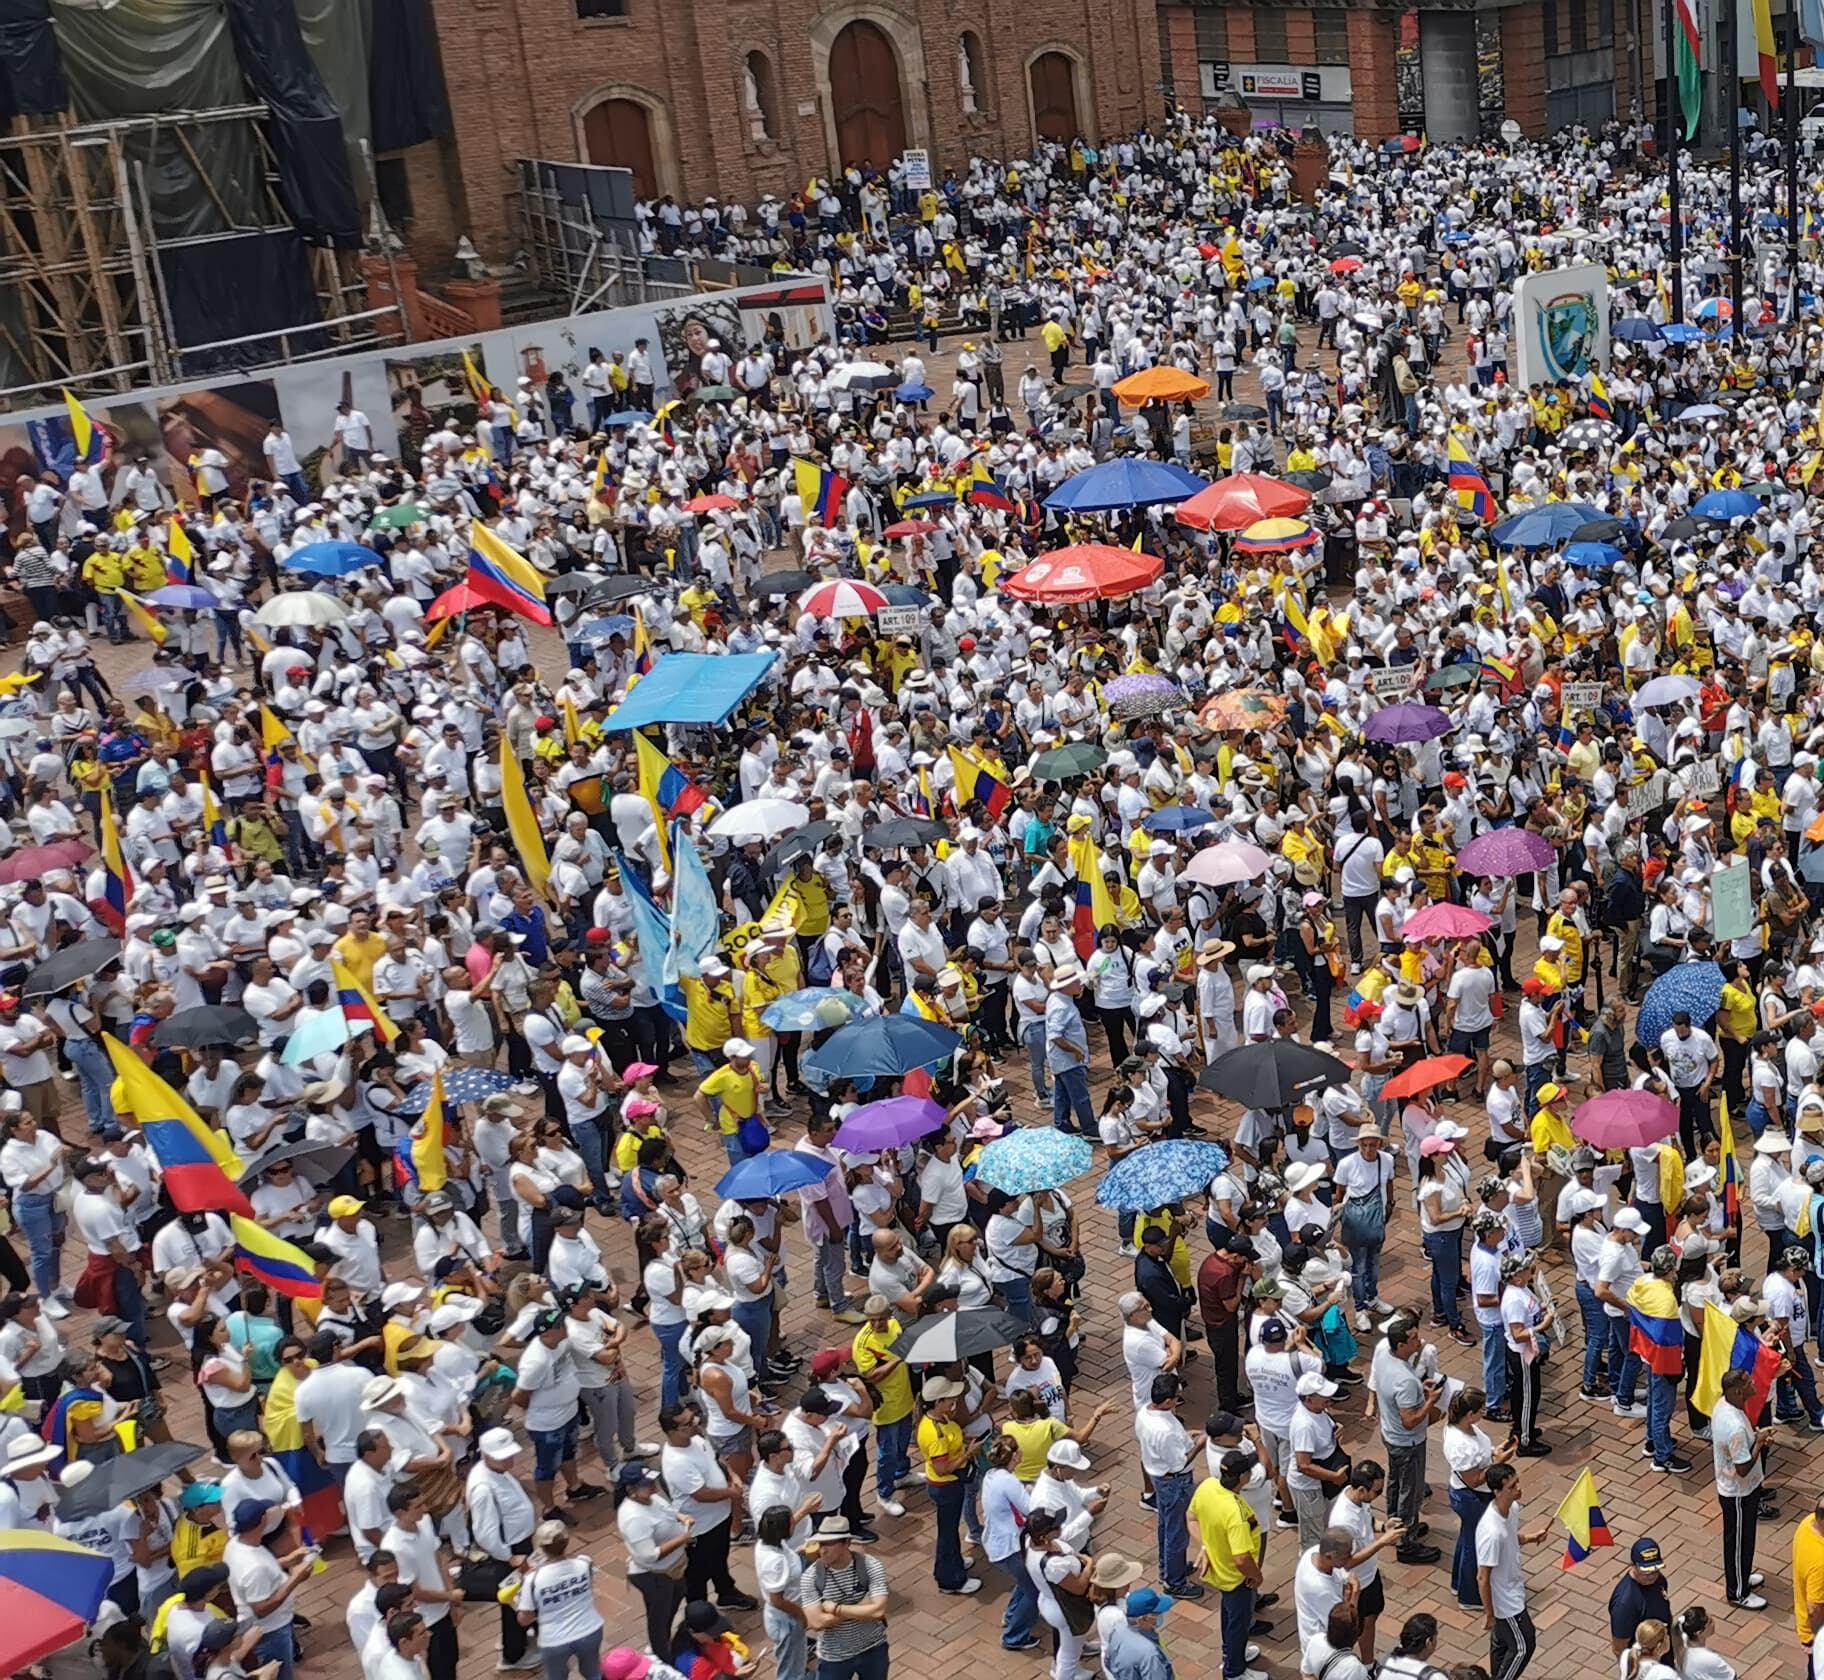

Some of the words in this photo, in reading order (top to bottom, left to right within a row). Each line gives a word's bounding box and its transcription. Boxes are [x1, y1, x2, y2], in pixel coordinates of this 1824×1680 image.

[882, 616, 900, 625] ART.
[901, 613, 916, 625] 109
[1396, 674, 1412, 684] 109
[541, 1573, 588, 1596] FUERA
[543, 1582, 589, 1607] PETRO
